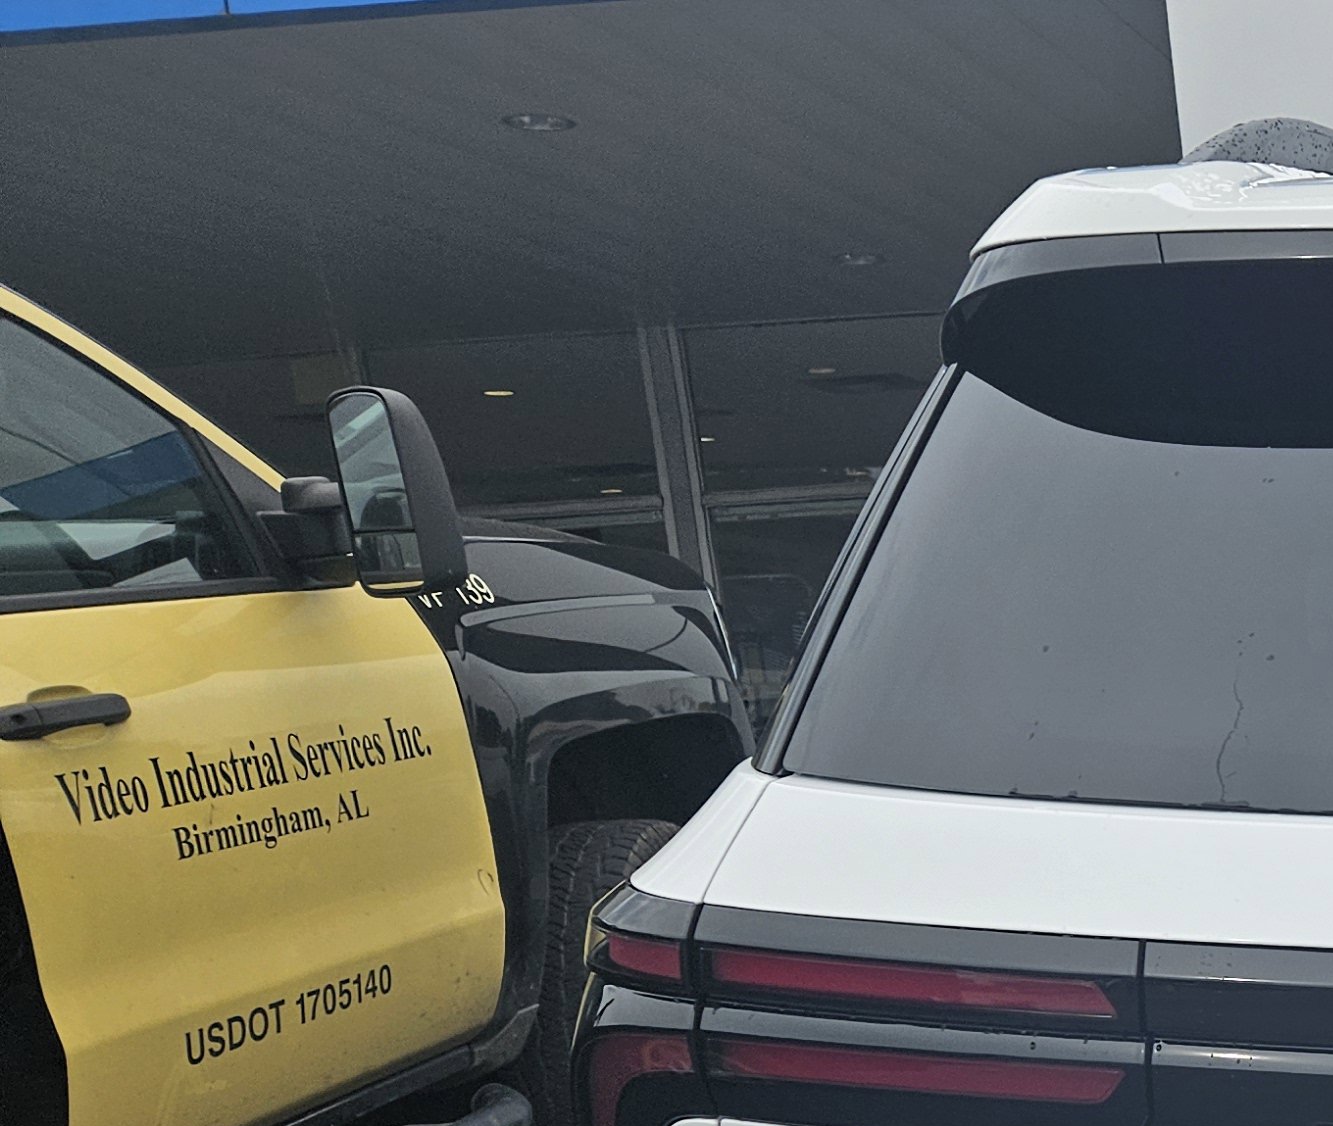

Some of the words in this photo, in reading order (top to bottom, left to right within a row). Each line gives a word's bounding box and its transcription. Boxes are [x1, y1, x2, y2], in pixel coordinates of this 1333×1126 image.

[54, 766, 149, 826] Video
[148, 737, 289, 809] Industrial
[286, 724, 387, 782] Services
[383, 717, 432, 762] Inc.
[172, 805, 332, 861] Birmingham,
[337, 789, 370, 824] AL
[185, 998, 286, 1066] USDOT
[296, 964, 393, 1025] 1705140
